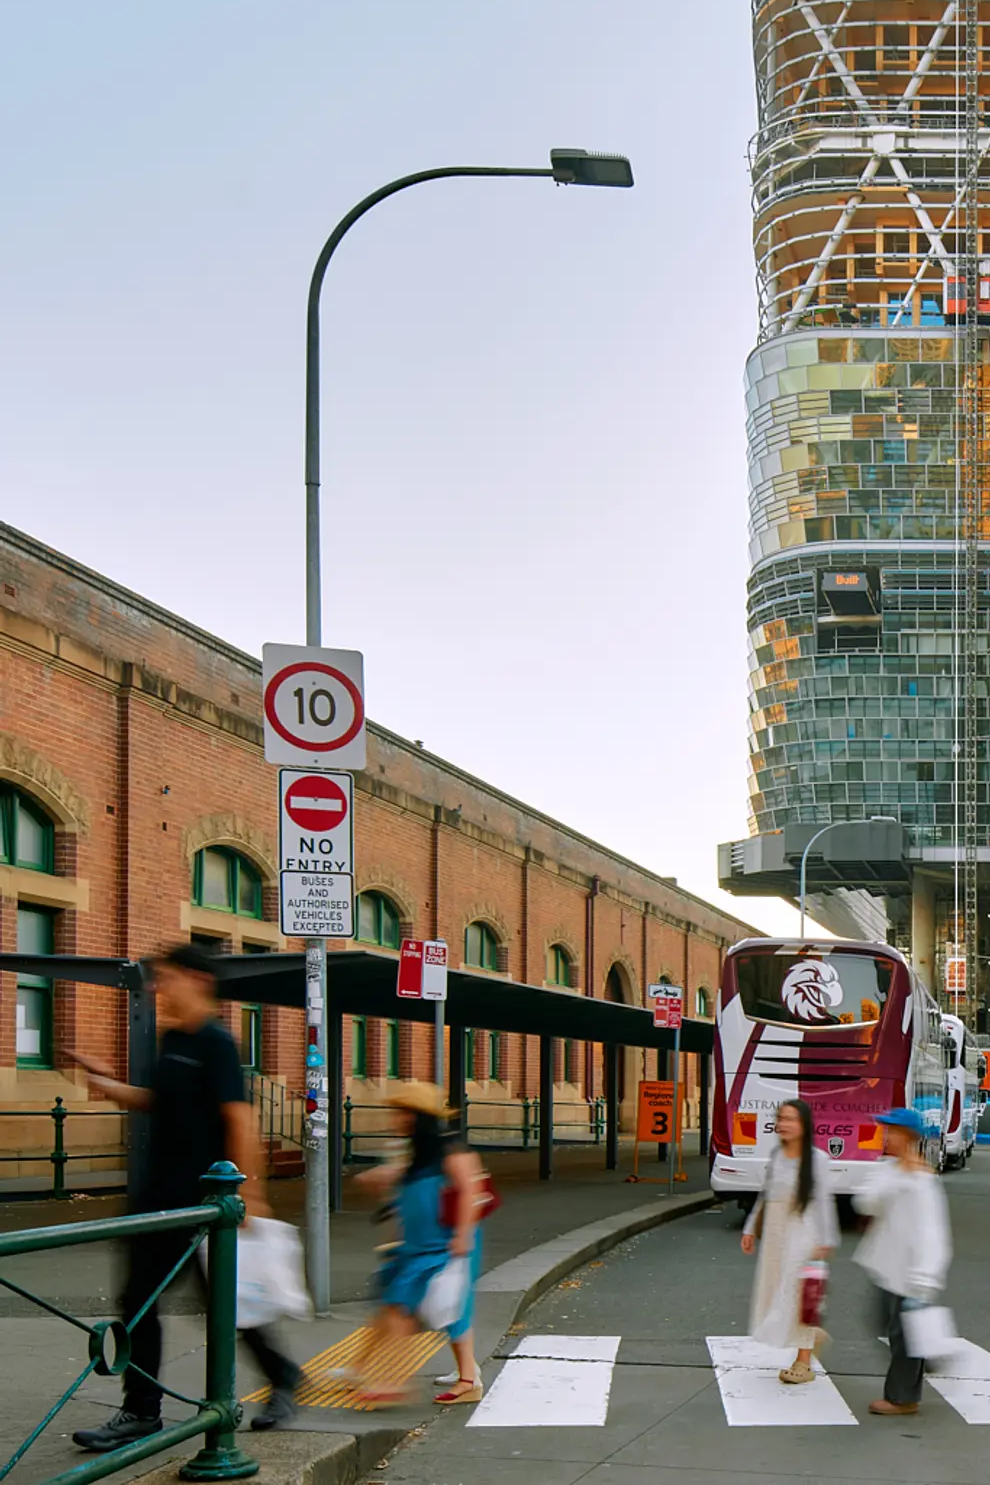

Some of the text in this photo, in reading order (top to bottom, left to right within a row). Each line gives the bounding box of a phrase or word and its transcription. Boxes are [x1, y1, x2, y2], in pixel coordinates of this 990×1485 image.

[293, 687, 336, 727] 10
[300, 837, 333, 855] NO
[286, 858, 346, 872] ENTRY
[301, 876, 334, 886] BUSES
[307, 888, 329, 897] AND
[287, 899, 349, 909] AUTHORISED
[294, 910, 342, 921] VEHICLES
[293, 921, 345, 932] EXCEPTED
[428, 946, 444, 956] BUS
[426, 955, 445, 964] ZONE
[644, 1091, 675, 1100] Regiona
[832, 1102, 888, 1114] COACHES
[651, 1111, 668, 1135] 3
